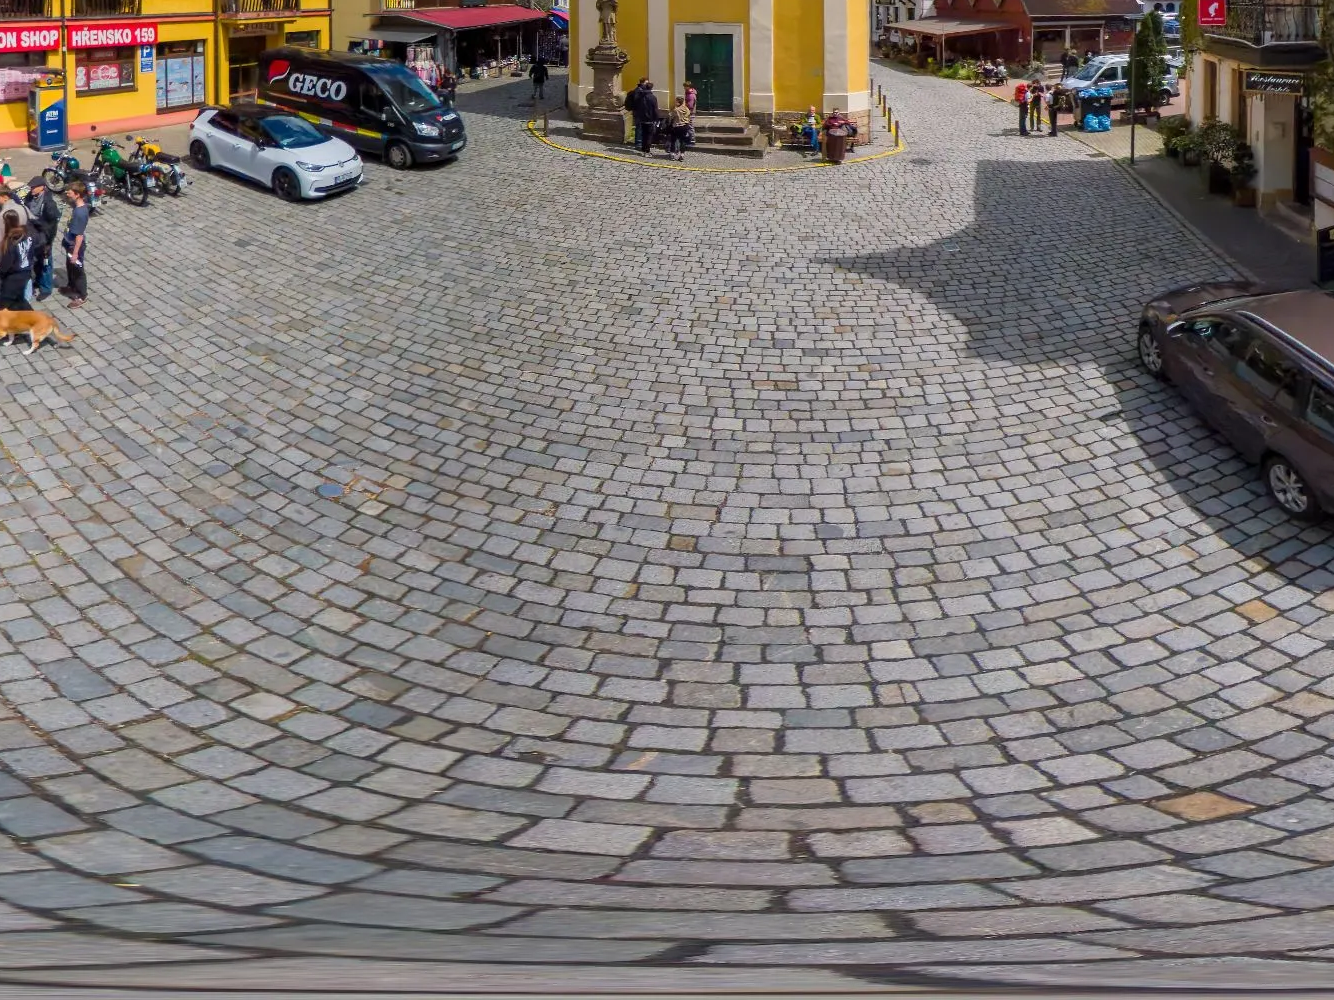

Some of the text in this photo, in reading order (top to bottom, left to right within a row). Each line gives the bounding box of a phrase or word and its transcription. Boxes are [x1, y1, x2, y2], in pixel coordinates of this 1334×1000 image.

[20, 30, 59, 48] SHOP
[71, 27, 155, 47] HŘENSKO 159
[288, 73, 347, 102] GECO
